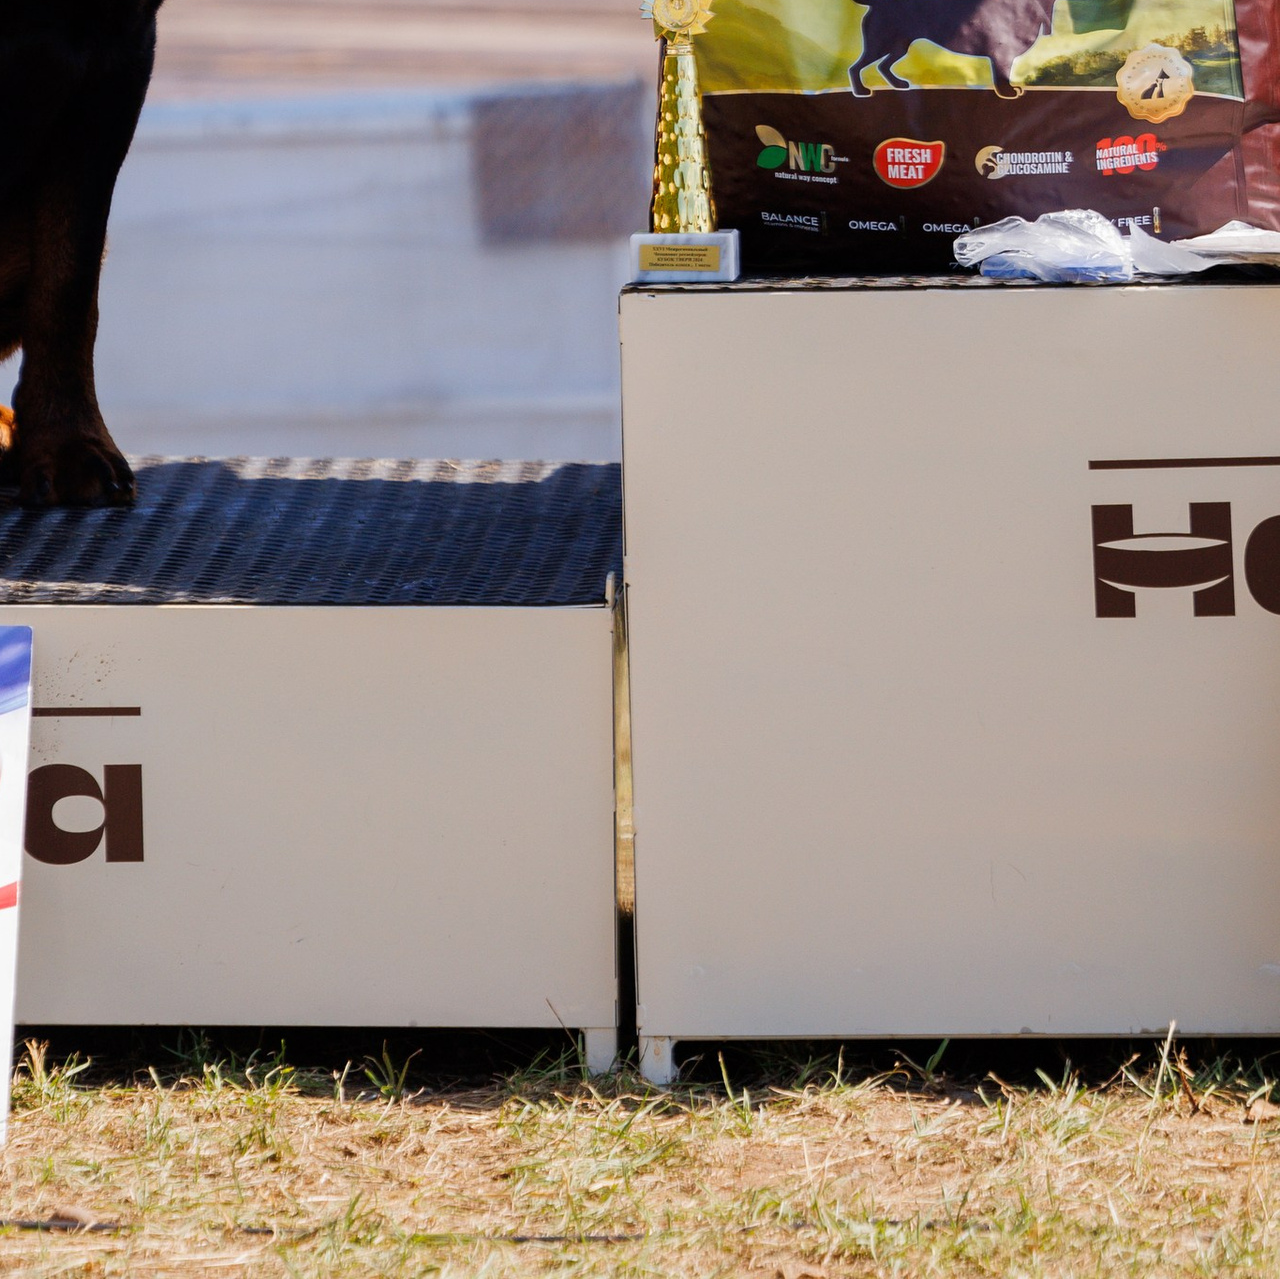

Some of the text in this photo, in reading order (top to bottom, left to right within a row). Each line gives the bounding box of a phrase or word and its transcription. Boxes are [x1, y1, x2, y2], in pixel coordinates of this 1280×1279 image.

[788, 140, 836, 174] NWC
[886, 147, 932, 164] FRESH
[996, 151, 1073, 165] CHONDROTIN &
[1096, 143, 1138, 159] NATURAL
[1097, 151, 1158, 170] INGREDIENTS
[888, 164, 925, 179] MEAT
[997, 162, 1070, 175] GLUCOSAMINE
[774, 171, 838, 185] natural way concept
[761, 211, 819, 226] BALANCE
[848, 220, 897, 232] OMEGA
[922, 222, 970, 233] OMEGA
